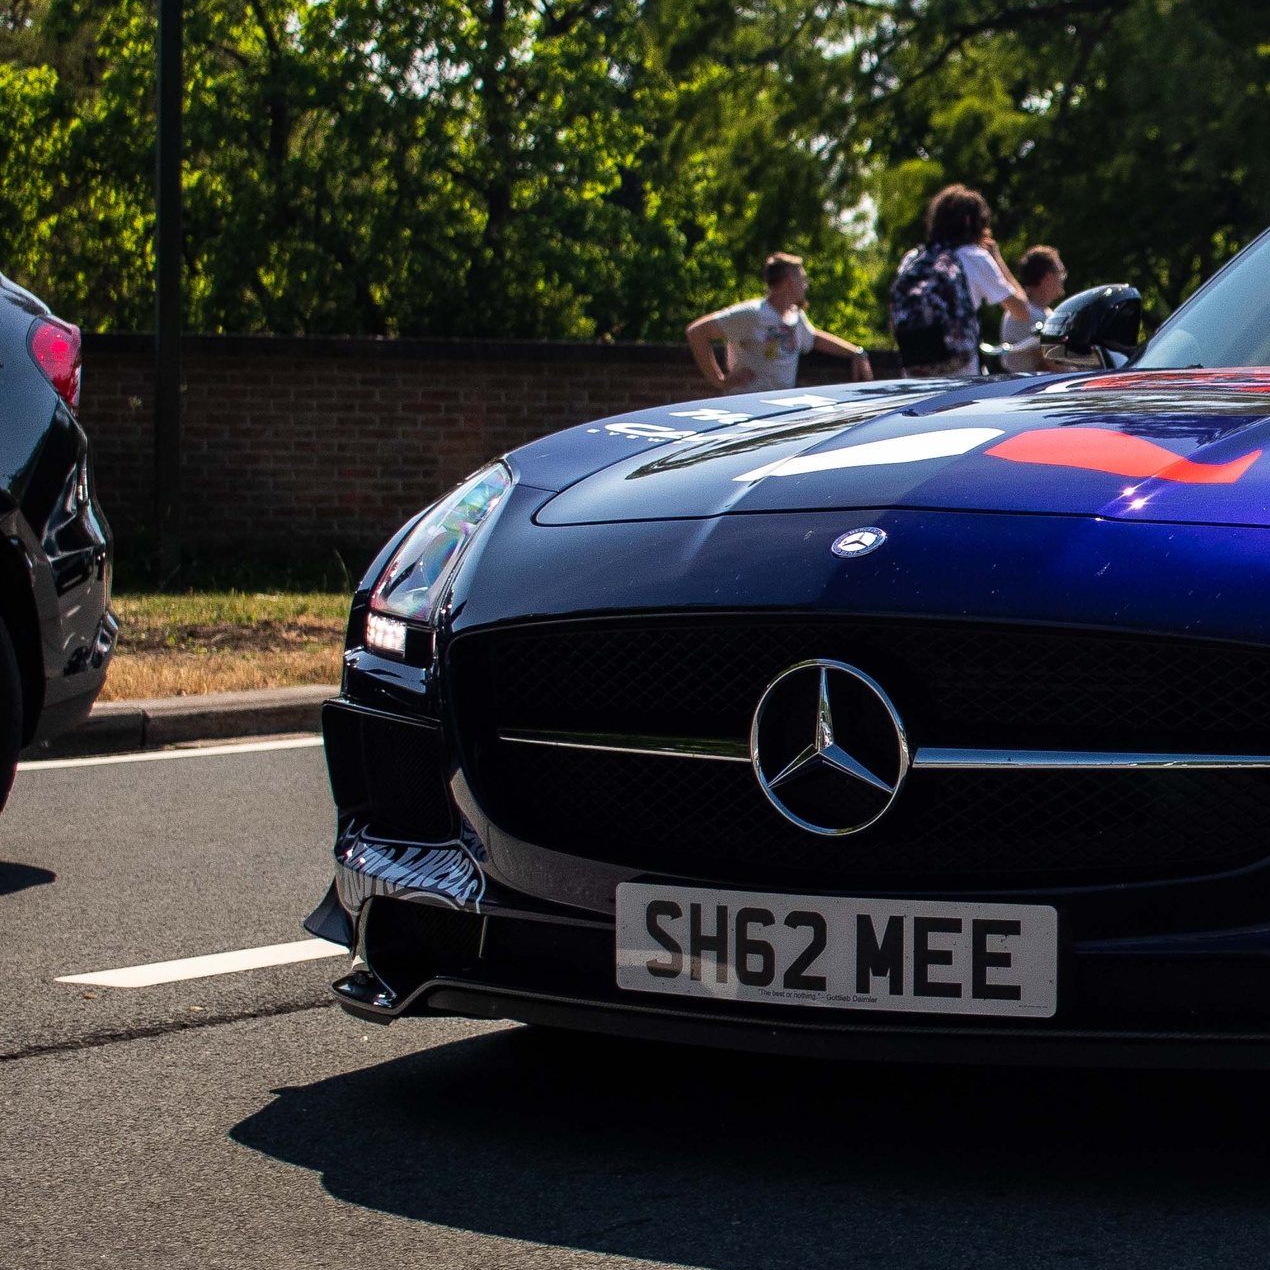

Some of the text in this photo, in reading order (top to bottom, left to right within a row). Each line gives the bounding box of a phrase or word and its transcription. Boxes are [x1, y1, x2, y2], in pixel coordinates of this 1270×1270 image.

[644, 899, 1022, 1001] SH62 MEE
[772, 990, 786, 998] best
[826, 994, 851, 1003] Gottlieb
[852, 995, 878, 1004] Daimler
